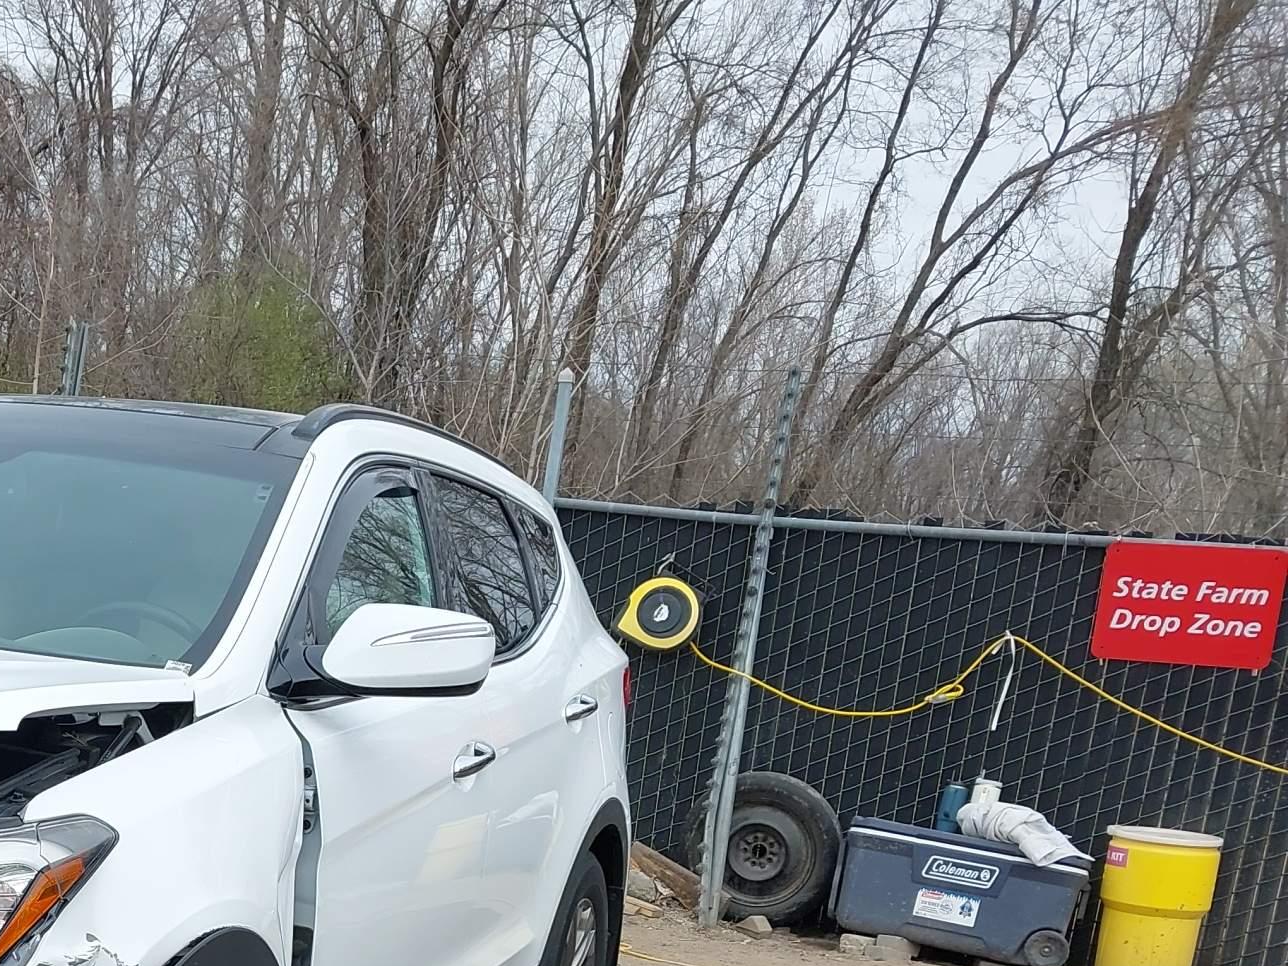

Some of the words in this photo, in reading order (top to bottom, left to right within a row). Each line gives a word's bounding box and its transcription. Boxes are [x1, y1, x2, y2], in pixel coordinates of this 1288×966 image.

[1112, 576, 1189, 601] State
[1195, 581, 1270, 606] Farm
[1109, 608, 1181, 637] Drop
[1187, 613, 1262, 638] Zone
[1111, 851, 1126, 863] KIT
[932, 860, 980, 879] Coleman
